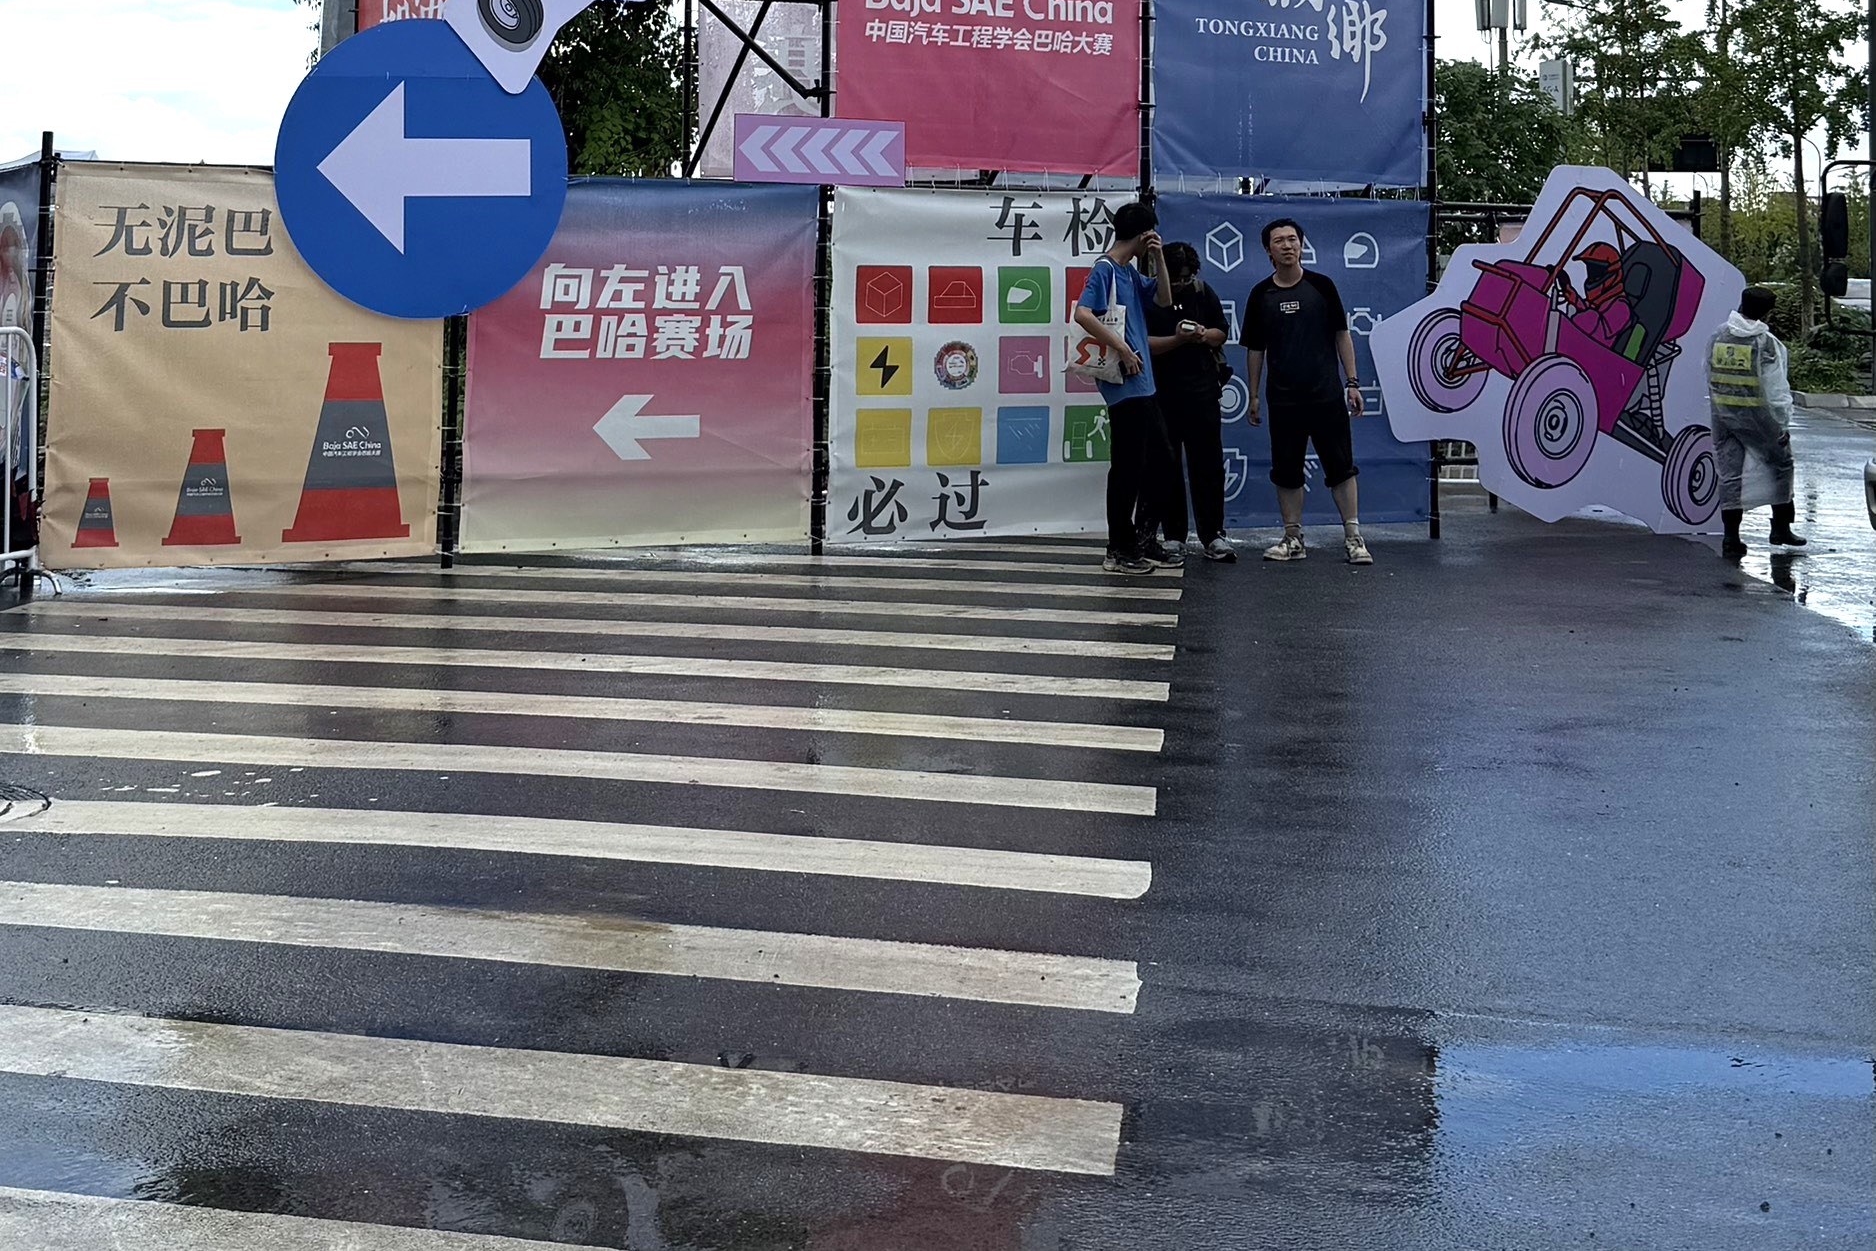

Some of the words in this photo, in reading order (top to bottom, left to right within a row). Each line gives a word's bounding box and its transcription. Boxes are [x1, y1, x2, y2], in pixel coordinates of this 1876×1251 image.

[865, 18, 1114, 57] 中国汽车工程学会巴哈大赛
[1195, 17, 1320, 41] TONGXIANG
[1254, 45, 1320, 65] CHINA
[92, 203, 275, 258] 无泥巴
[987, 196, 1116, 257] 车检
[90, 276, 276, 333] 不巴哈
[539, 263, 752, 311] 向左进入
[539, 314, 754, 360] 巴哈赛场
[322, 441, 342, 451] Baja
[342, 440, 359, 450] SAE
[359, 440, 382, 450] China
[847, 470, 990, 536] 必过
